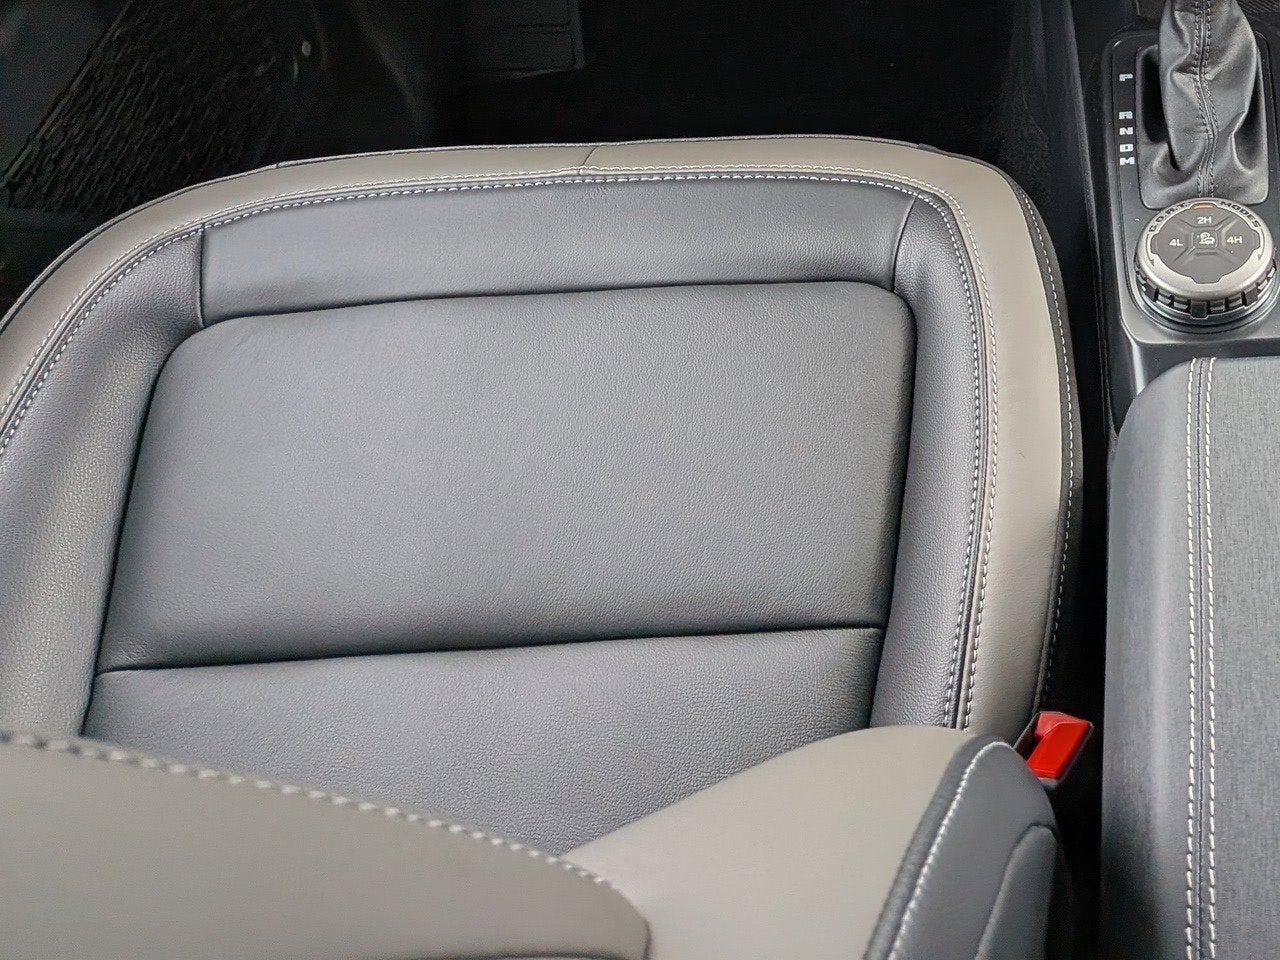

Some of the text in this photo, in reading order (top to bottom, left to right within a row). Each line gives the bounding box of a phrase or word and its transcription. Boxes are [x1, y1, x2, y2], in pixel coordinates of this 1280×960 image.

[1118, 111, 1133, 120] R
[1119, 127, 1133, 136] N
[1119, 143, 1133, 153] D
[1119, 157, 1135, 166] M
[1220, 201, 1261, 228] MODES
[1197, 216, 1212, 224] 2H
[1169, 238, 1184, 246] 4L
[1226, 235, 1243, 244] 4H
